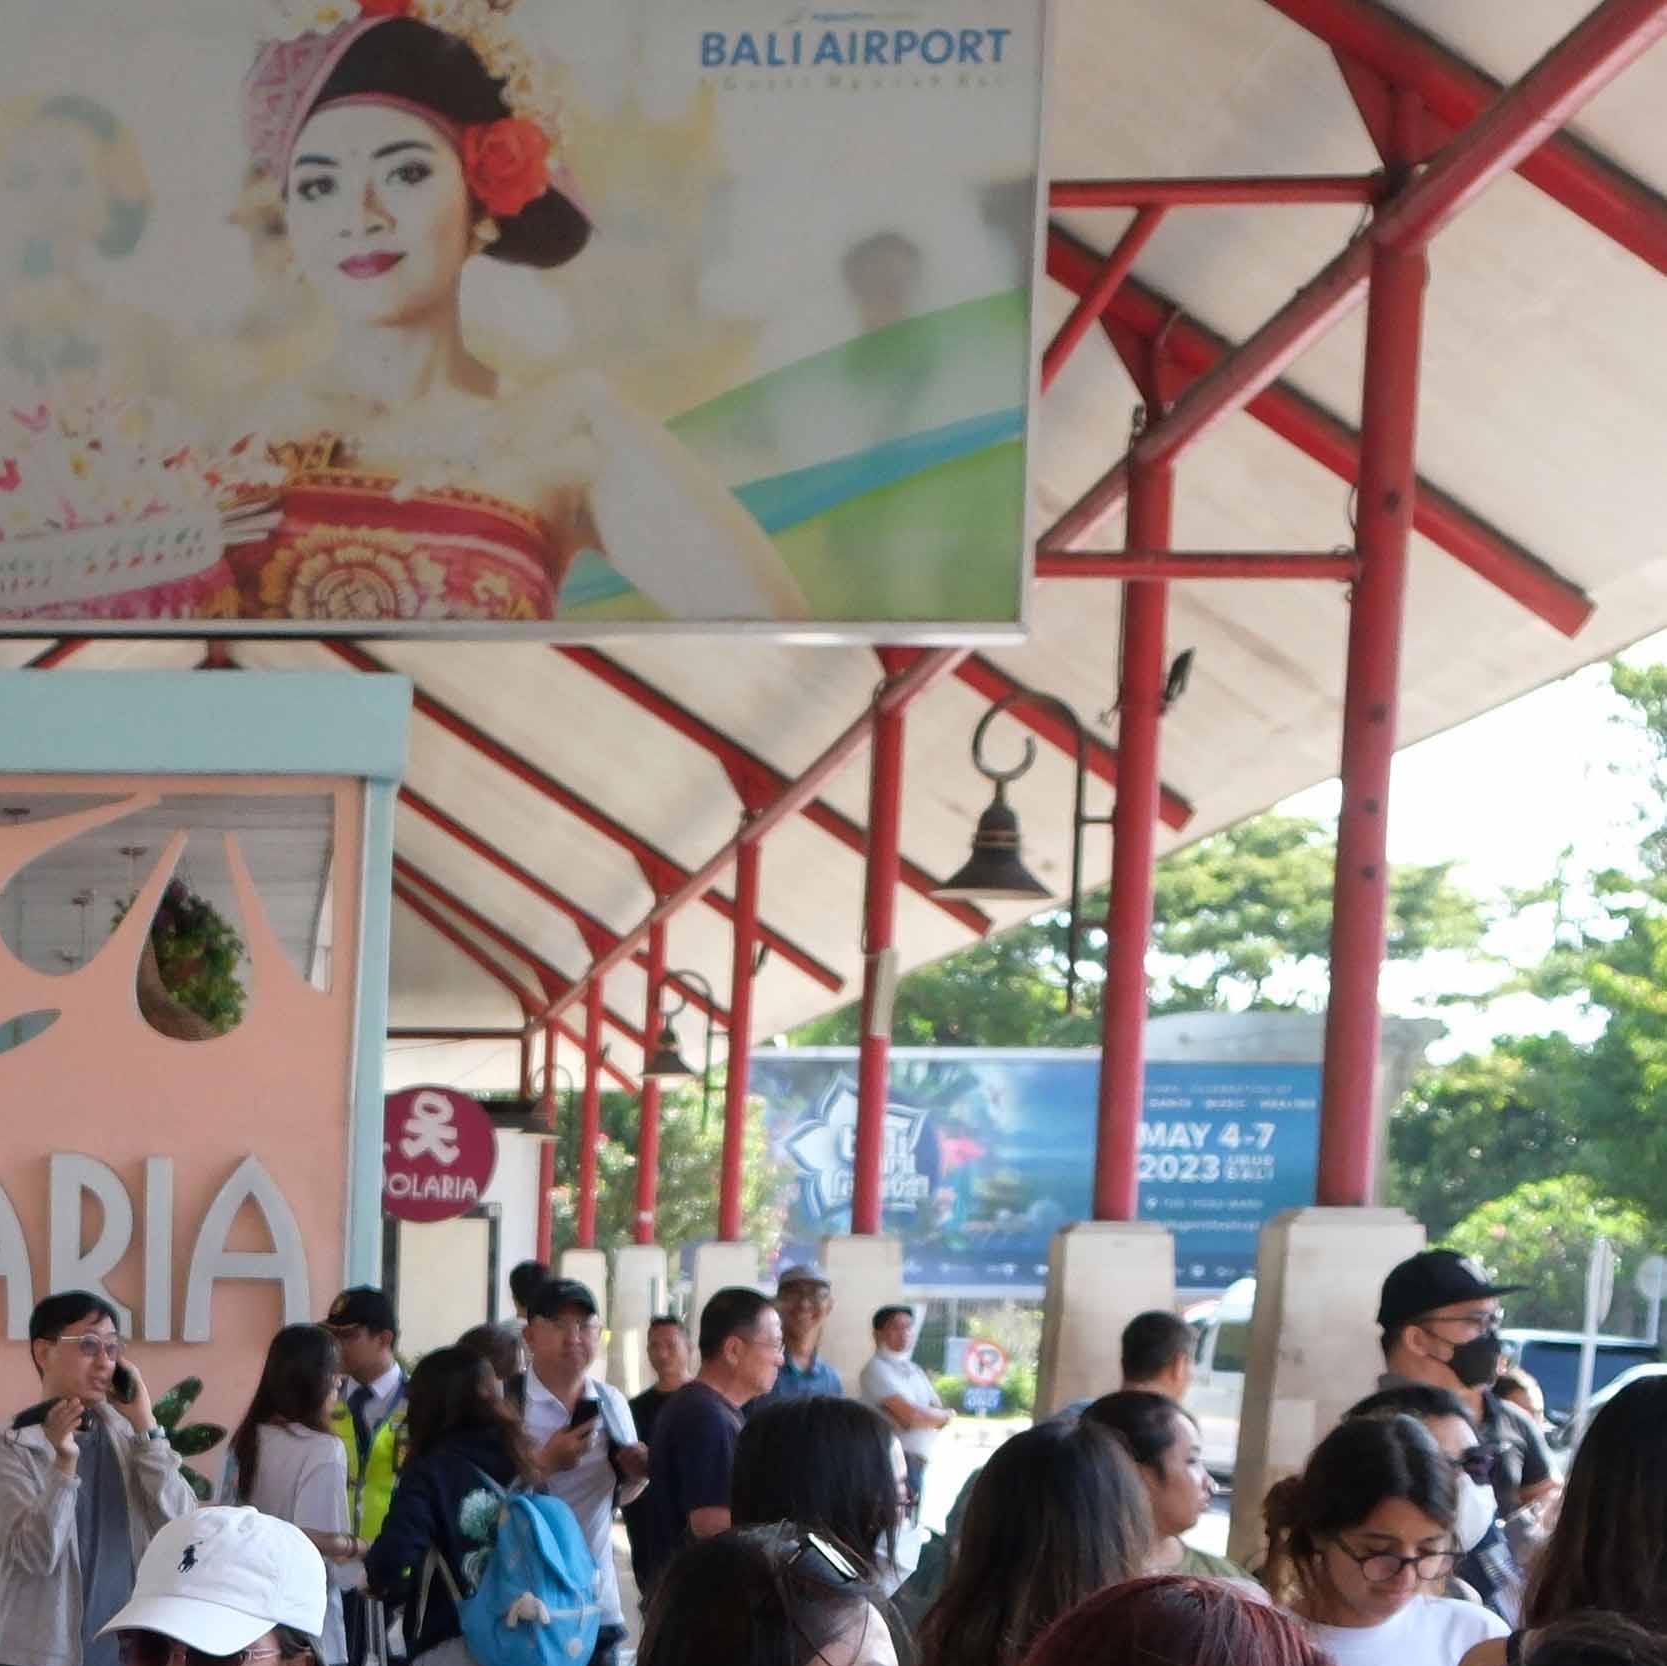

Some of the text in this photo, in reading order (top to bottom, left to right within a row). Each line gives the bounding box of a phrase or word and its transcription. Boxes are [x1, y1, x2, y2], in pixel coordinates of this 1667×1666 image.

[700, 28, 1012, 67] BALI AIRPORT
[1137, 1122, 1277, 1149] MAY 4-7
[1137, 1153, 1222, 1184] 2023
[385, 1173, 479, 1200] OLARIA
